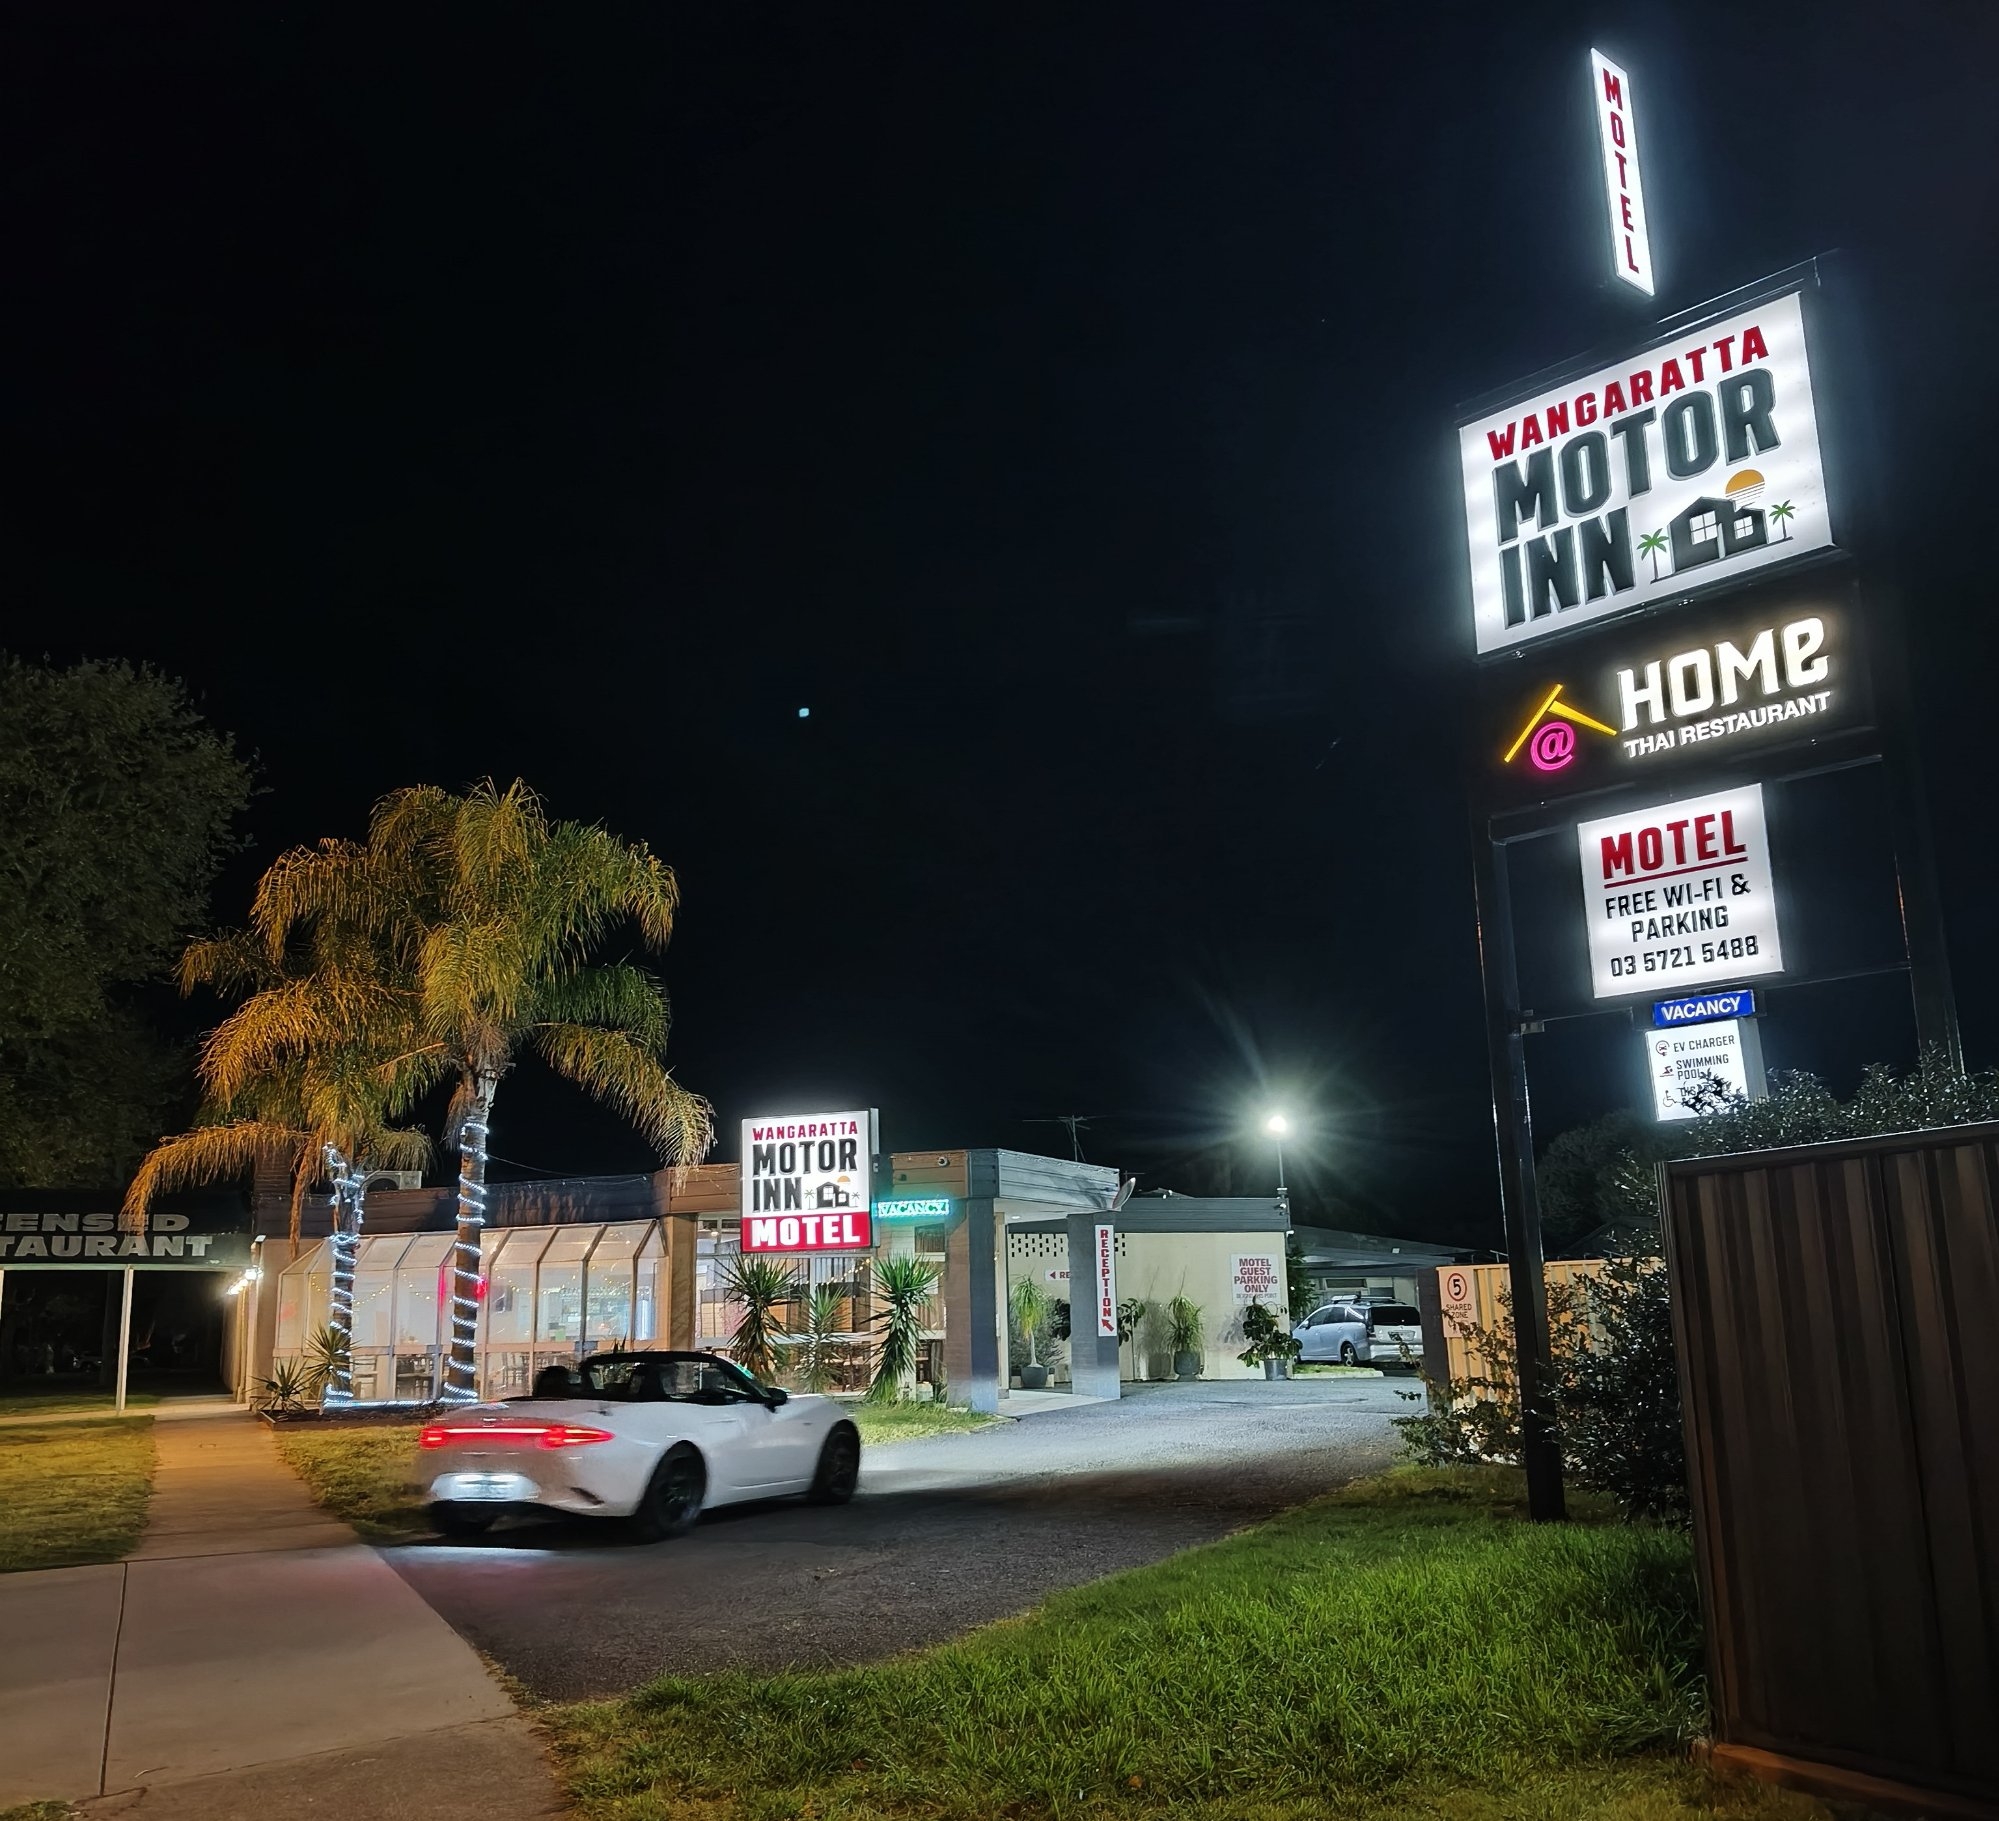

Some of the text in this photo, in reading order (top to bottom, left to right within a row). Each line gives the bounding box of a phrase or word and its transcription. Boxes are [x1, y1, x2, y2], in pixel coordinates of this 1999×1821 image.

[1603, 68, 1639, 273] MOTEL
[1487, 325, 1769, 461] WANGARATTA
[1492, 367, 1782, 546] MOTOR
[1498, 506, 1636, 630] INN
[1624, 691, 1831, 759] THAI RESTAURANT
[1530, 721, 1575, 771] @
[1600, 809, 1747, 880] MOTEL
[1605, 873, 1751, 919] FREE WI-FI &
[1631, 905, 1729, 942] PARKING
[1610, 935, 1759, 977] 03 5721 5488
[1661, 996, 1741, 1021] VACANCY
[1673, 1035, 1735, 1053] EV CHARGER
[1676, 1054, 1730, 1070] SWIMMING
[752, 1121, 858, 1141] WANGARATTA
[752, 1138, 858, 1178] MOTOR
[753, 1177, 802, 1213] INN
[879, 1200, 948, 1216] VACANCY
[0, 1213, 190, 1232] ENSED
[751, 1215, 861, 1248] MOTEL
[1100, 1229, 1112, 1317] RECEPTION
[1239, 1258, 1271, 1267] MOTEL
[1240, 1267, 1271, 1276] GUEST
[1234, 1276, 1278, 1284] PARKING
[1244, 1284, 1269, 1293] ONLY
[1453, 1279, 1462, 1296] 5
[1451, 1311, 1469, 1319] ZONE
